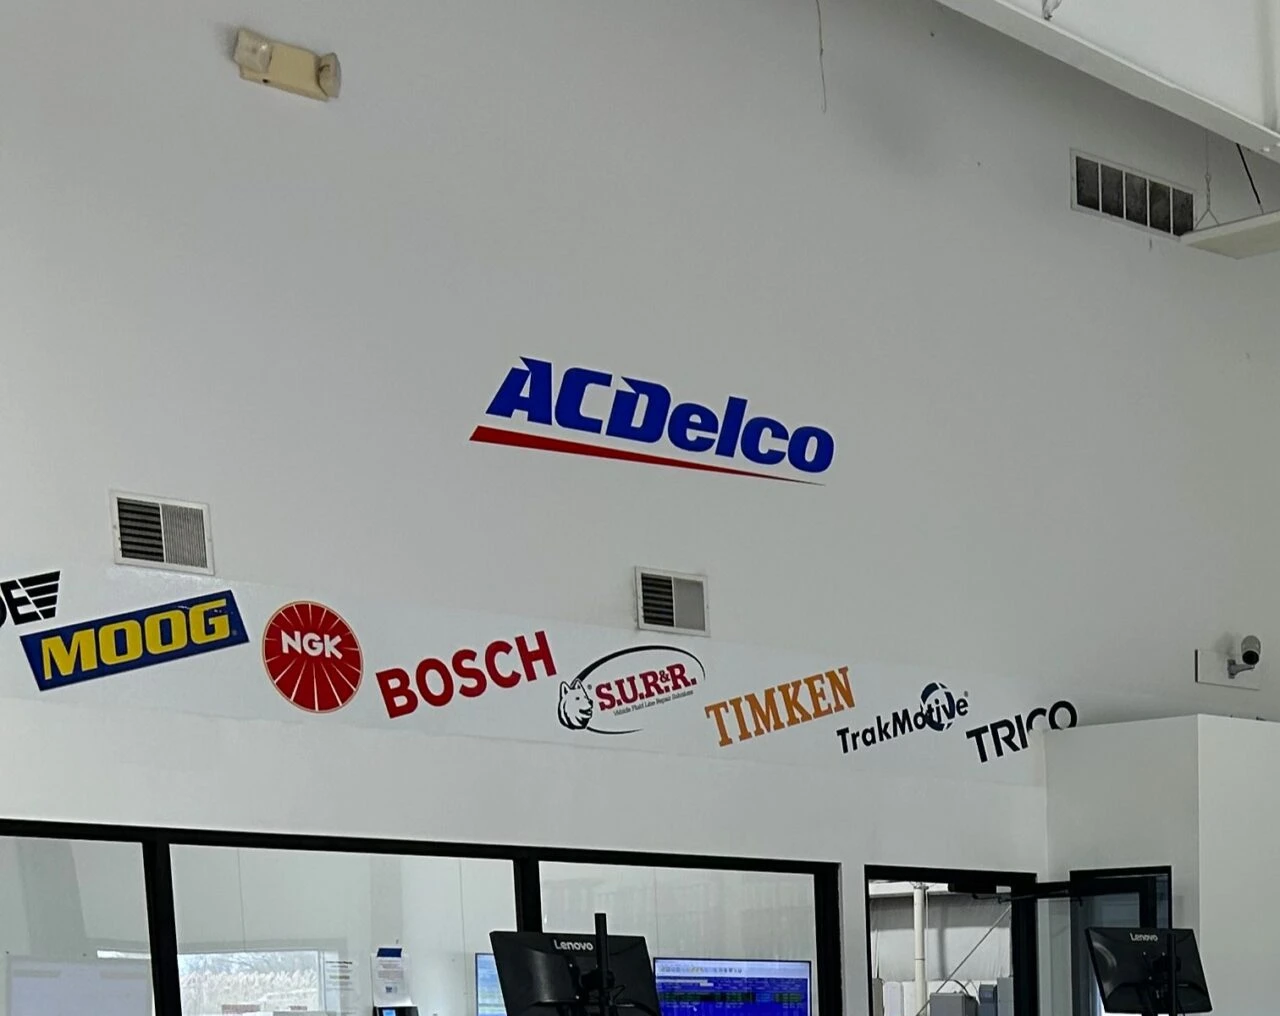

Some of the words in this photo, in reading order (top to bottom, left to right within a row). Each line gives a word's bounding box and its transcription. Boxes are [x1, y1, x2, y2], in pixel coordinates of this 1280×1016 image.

[486, 356, 834, 474] ACDelco
[41, 598, 230, 680] MOOG
[280, 630, 343, 660] NGK
[375, 630, 557, 719] BOSCH
[704, 666, 856, 747] TIMKEN
[837, 696, 969, 754] TrakMotive
[554, 939, 594, 952] Lenovo
[1130, 933, 1158, 941] Lenovo
